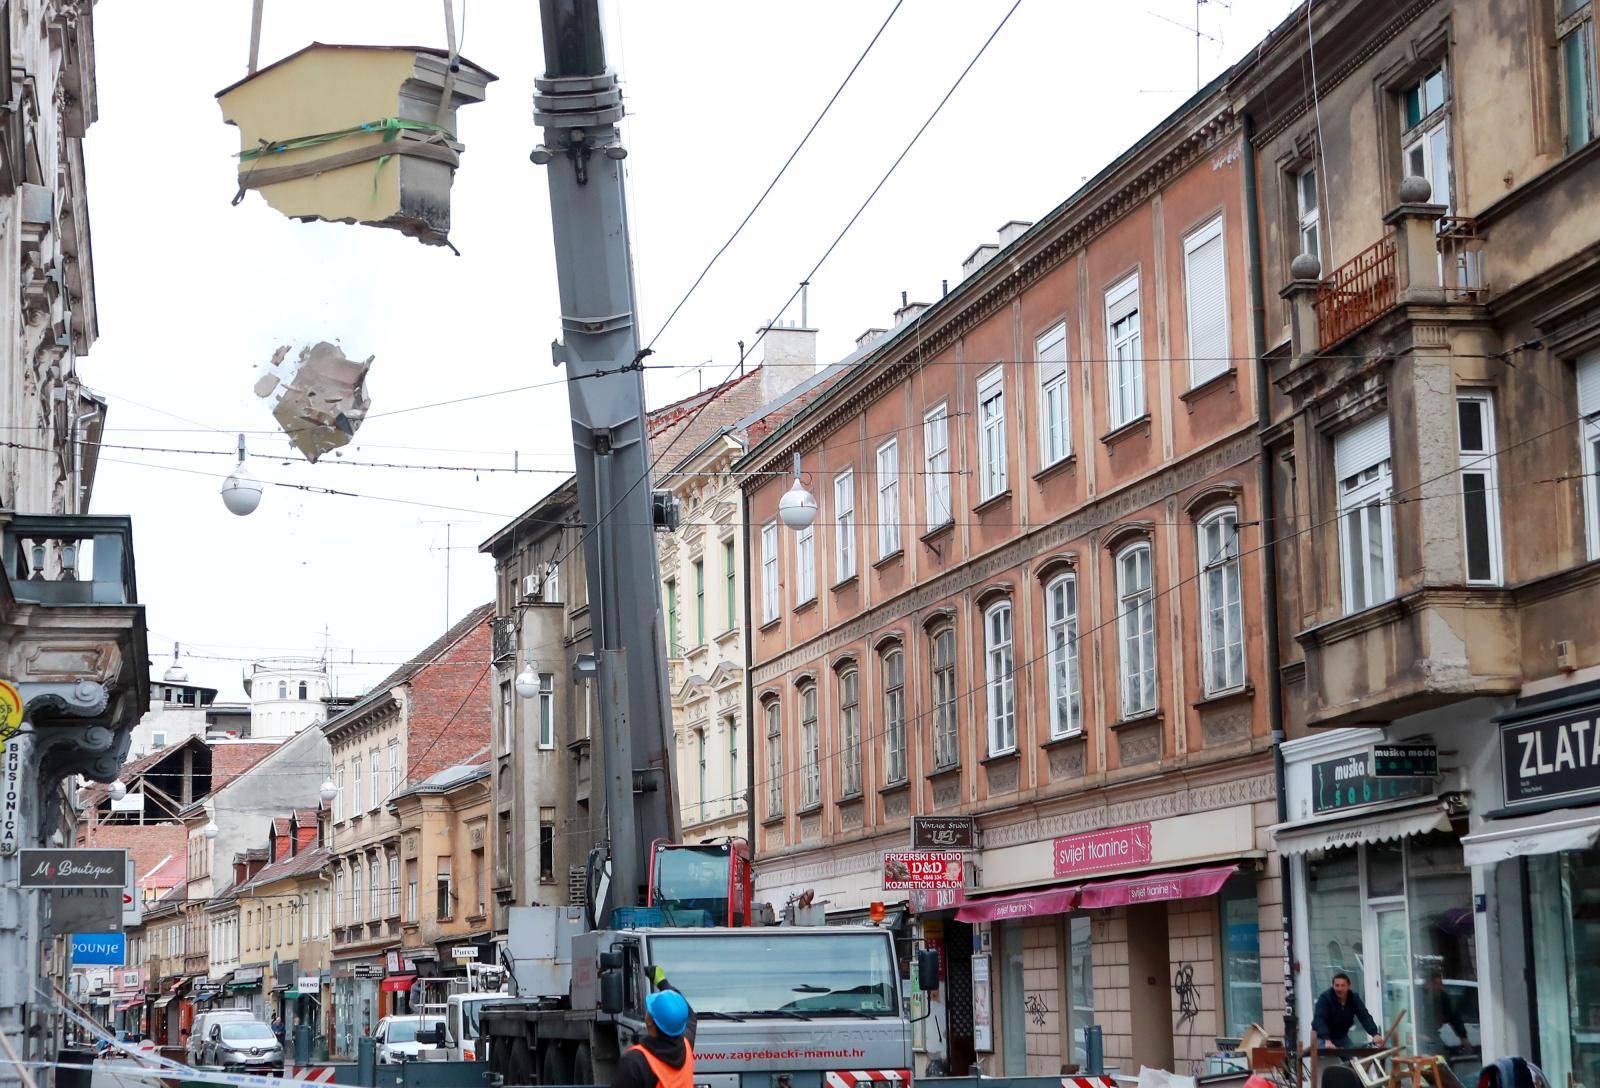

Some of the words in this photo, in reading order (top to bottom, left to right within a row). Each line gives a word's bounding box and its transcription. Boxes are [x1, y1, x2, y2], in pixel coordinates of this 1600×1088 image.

[1375, 748, 1406, 757] muška
[1408, 747, 1436, 757] moda
[1335, 758, 1365, 781] muška
[5, 743, 18, 839] BRUSIONICA
[885, 853, 928, 861] FRIZERSKI
[931, 853, 961, 861] STUDIO
[1060, 844, 1086, 866] svijet
[1088, 838, 1129, 860] tkanine
[57, 860, 114, 879] Boutique
[911, 861, 942, 874] D&D
[885, 881, 935, 889] KOZMETIČKI
[937, 881, 962, 889] SALON
[937, 889, 954, 907] D&D
[692, 1048, 866, 1061] www.zagrebacki-mamut.hr
